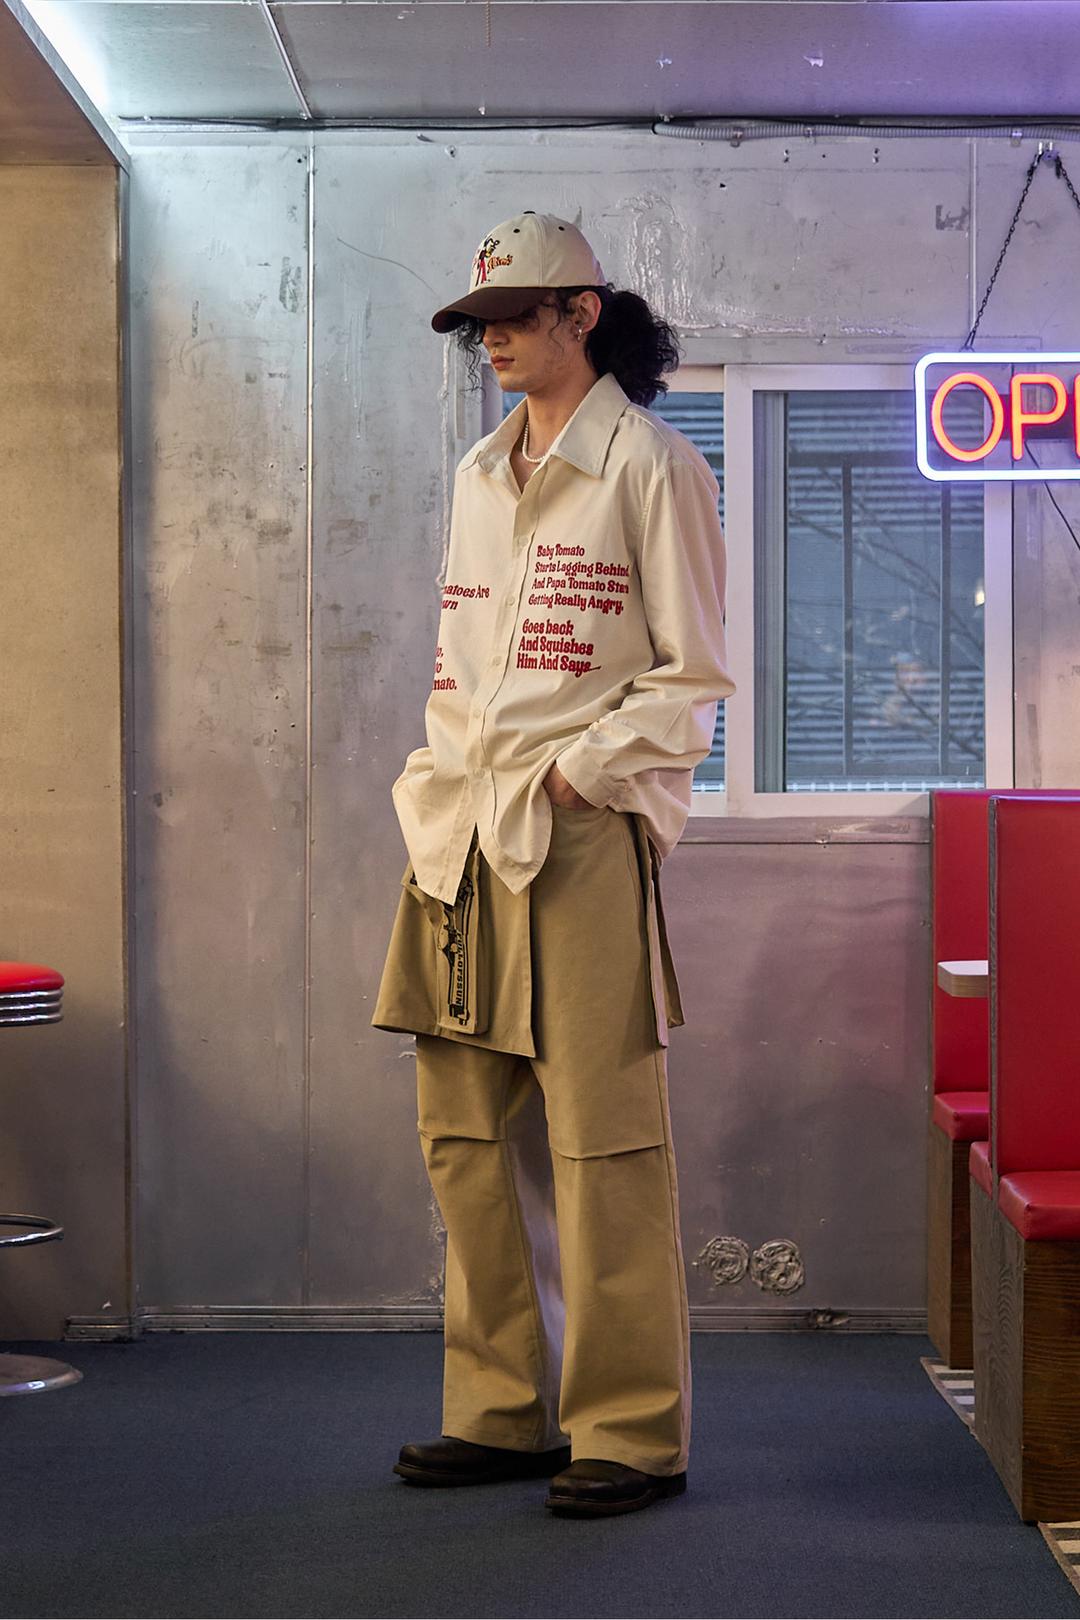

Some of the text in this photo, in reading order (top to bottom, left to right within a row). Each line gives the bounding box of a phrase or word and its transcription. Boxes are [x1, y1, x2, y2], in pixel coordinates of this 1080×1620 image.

[931, 372, 1080, 463] OP
[537, 543, 585, 560] Baby Tomato
[535, 562, 556, 573] Starts
[556, 560, 594, 578] Lagging
[475, 584, 490, 599] Are
[532, 578, 546, 590] And
[546, 577, 566, 591] Papa
[567, 577, 606, 592] Tomato
[528, 594, 554, 609] Getting
[554, 593, 587, 611] Really
[522, 618, 575, 636] Goes back
[518, 635, 594, 656] And Squishes
[516, 653, 538, 669] Him
[538, 654, 559, 671] And
